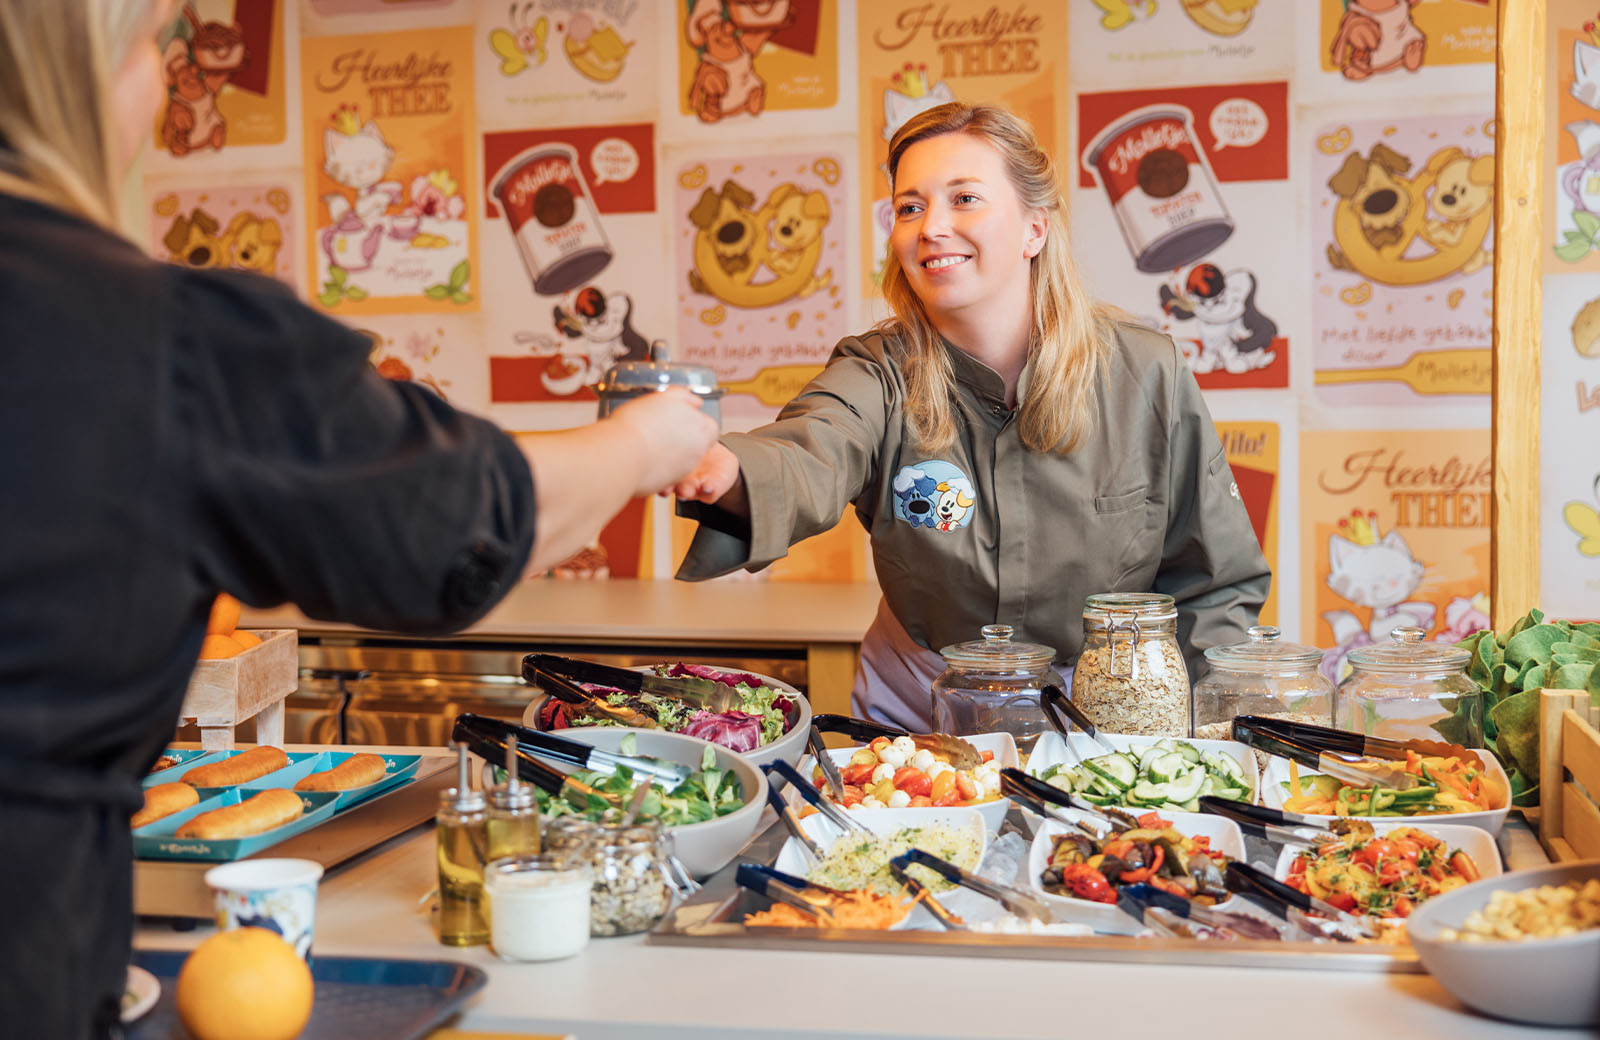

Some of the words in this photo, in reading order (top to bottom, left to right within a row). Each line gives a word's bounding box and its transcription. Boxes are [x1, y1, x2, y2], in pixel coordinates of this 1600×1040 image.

[873, 2, 1043, 51] Heerlijke
[314, 49, 454, 93] Heerlijke
[936, 38, 1040, 79] THEE
[367, 81, 453, 119] THEE
[1318, 448, 1492, 495] Heerlijk
